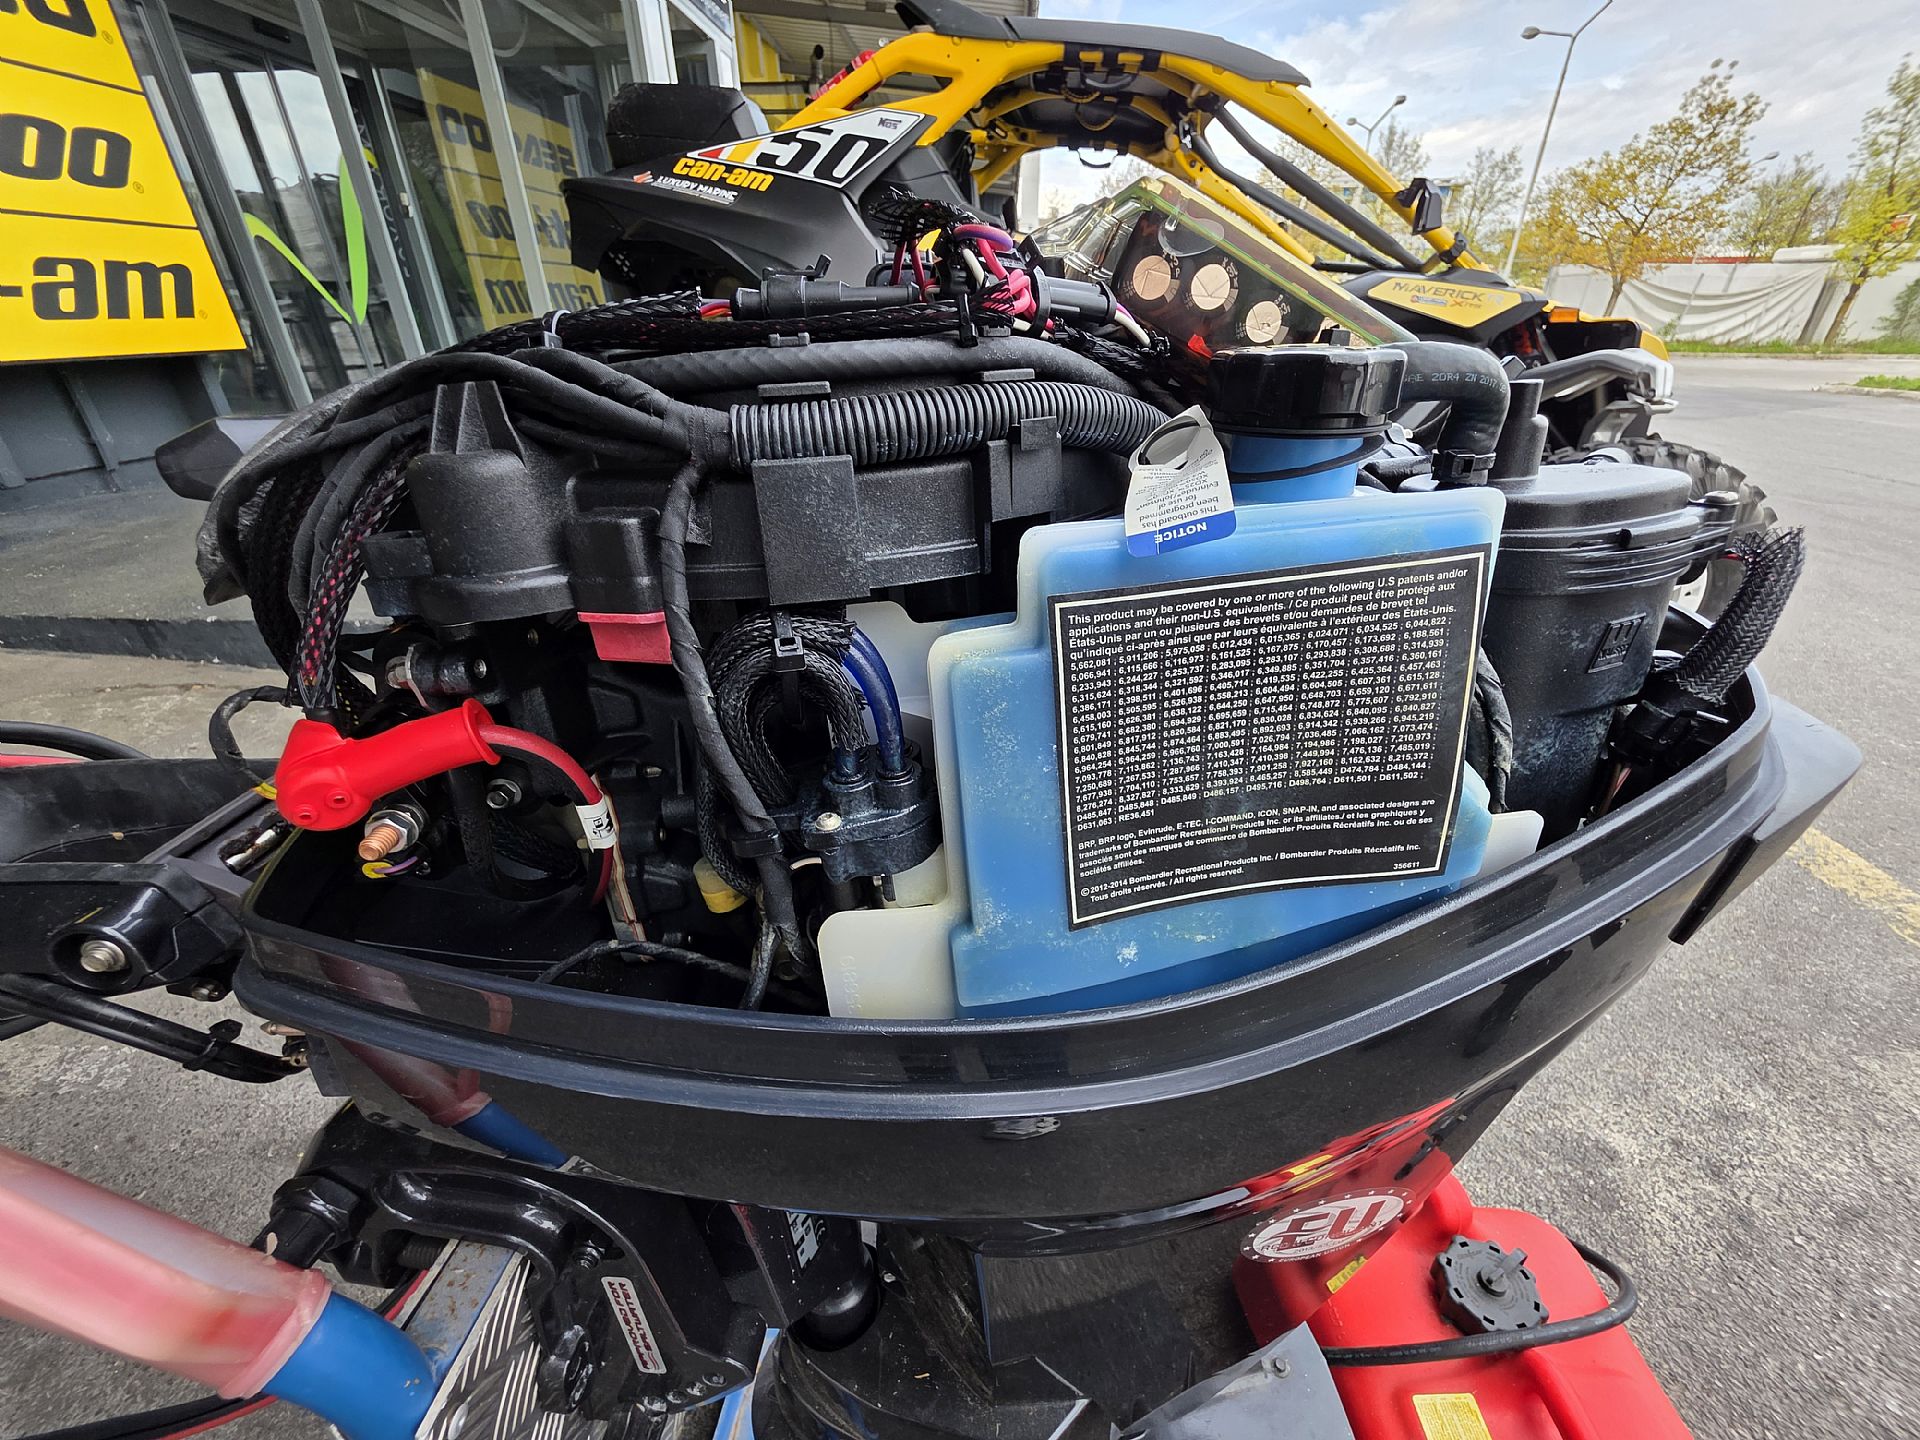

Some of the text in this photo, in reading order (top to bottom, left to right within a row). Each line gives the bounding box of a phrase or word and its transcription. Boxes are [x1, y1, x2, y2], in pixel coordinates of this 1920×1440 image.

[672, 157, 774, 192] can-am
[756, 126, 890, 181] 50
[657, 176, 698, 190] LUXURY
[697, 183, 738, 200] MARINE
[1392, 281, 1486, 302] MAVERICK
[1139, 496, 1219, 522] been programmed
[1142, 505, 1218, 528] This outboard has
[1158, 502, 1166, 510] of
[1153, 521, 1207, 543] NOTICE
[1067, 614, 1091, 624] This
[1093, 609, 1134, 623] product
[1136, 607, 1158, 616] may
[1160, 604, 1173, 613] be
[1175, 598, 1215, 611] covered
[1218, 597, 1231, 607] by
[1233, 595, 1252, 604] one
[1254, 593, 1266, 601] or
[1268, 590, 1295, 600] more
[1296, 586, 1308, 597] of
[1309, 586, 1326, 595] the
[1328, 580, 1375, 592] following
[1397, 573, 1435, 586] patents
[1436, 568, 1468, 580] and/or
[1068, 582, 1455, 637] applications and their non-U.S. equivalents. Ce produit peut être protégé aux
[1125, 632, 1142, 642] par
[1143, 630, 1157, 638] un
[1159, 628, 1172, 636] ou
[1174, 621, 1220, 635] plusieurs
[1222, 618, 1241, 627] des
[1243, 613, 1281, 624] brevets
[1283, 610, 1308, 620] et/ou
[1310, 604, 1363, 617] demandes
[1365, 601, 1379, 611] de
[1380, 598, 1413, 609] brevet
[1415, 595, 1428, 605] tel
[1126, 638, 1165, 651] ci-après
[1167, 634, 1191, 646] ainsi
[1193, 633, 1212, 643] que
[1214, 630, 1231, 641] par
[1233, 627, 1258, 636] leurs
[1260, 620, 1318, 634] équivalents
[1320, 617, 1327, 626] à
[1381, 611, 1401, 620] des
[1078, 839, 1097, 850] BRP,
[1098, 835, 1116, 845] BRP
[1116, 832, 1137, 841] logo,
[1138, 825, 1175, 836] Evinrude,
[1176, 819, 1203, 829] E-TEC,
[1257, 808, 1280, 817] ICON,
[1321, 803, 1337, 811] and
[1338, 801, 1385, 810] associated
[1386, 800, 1419, 808] designs
[1078, 844, 1122, 859] trademarks
[1123, 840, 1131, 849] of
[1132, 833, 1178, 847] Bombardier
[1179, 825, 1229, 838] Recreational
[1230, 820, 1265, 830] Products
[1370, 809, 1418, 819] graphiques
[1114, 850, 1132, 860] sont
[1132, 848, 1147, 856] des
[1148, 842, 1183, 852] marques
[1184, 839, 1194, 847] de
[1195, 833, 1236, 844] commerce
[1248, 825, 1295, 836] Bombardier
[1296, 823, 1331, 831] Produits
[1376, 819, 1392, 827] Inc.
[1405, 817, 1417, 825] de
[1090, 878, 1128, 893] 2012-2014
[1128, 870, 1174, 884] Bombardier
[1174, 861, 1223, 875] Recreational
[1223, 856, 1258, 866] Products
[1259, 854, 1273, 862] Inc.
[1279, 850, 1327, 859] Bombardier
[1327, 847, 1362, 855] Produits
[1090, 893, 1109, 902] Tous
[1110, 887, 1132, 898] droits
[1173, 876, 1184, 885] All
[1185, 873, 1208, 882] rights
[1209, 866, 1244, 878] reserved.
[608, 1281, 650, 1369] APPROVED FOR
[618, 1281, 653, 1352] SALTWATER
